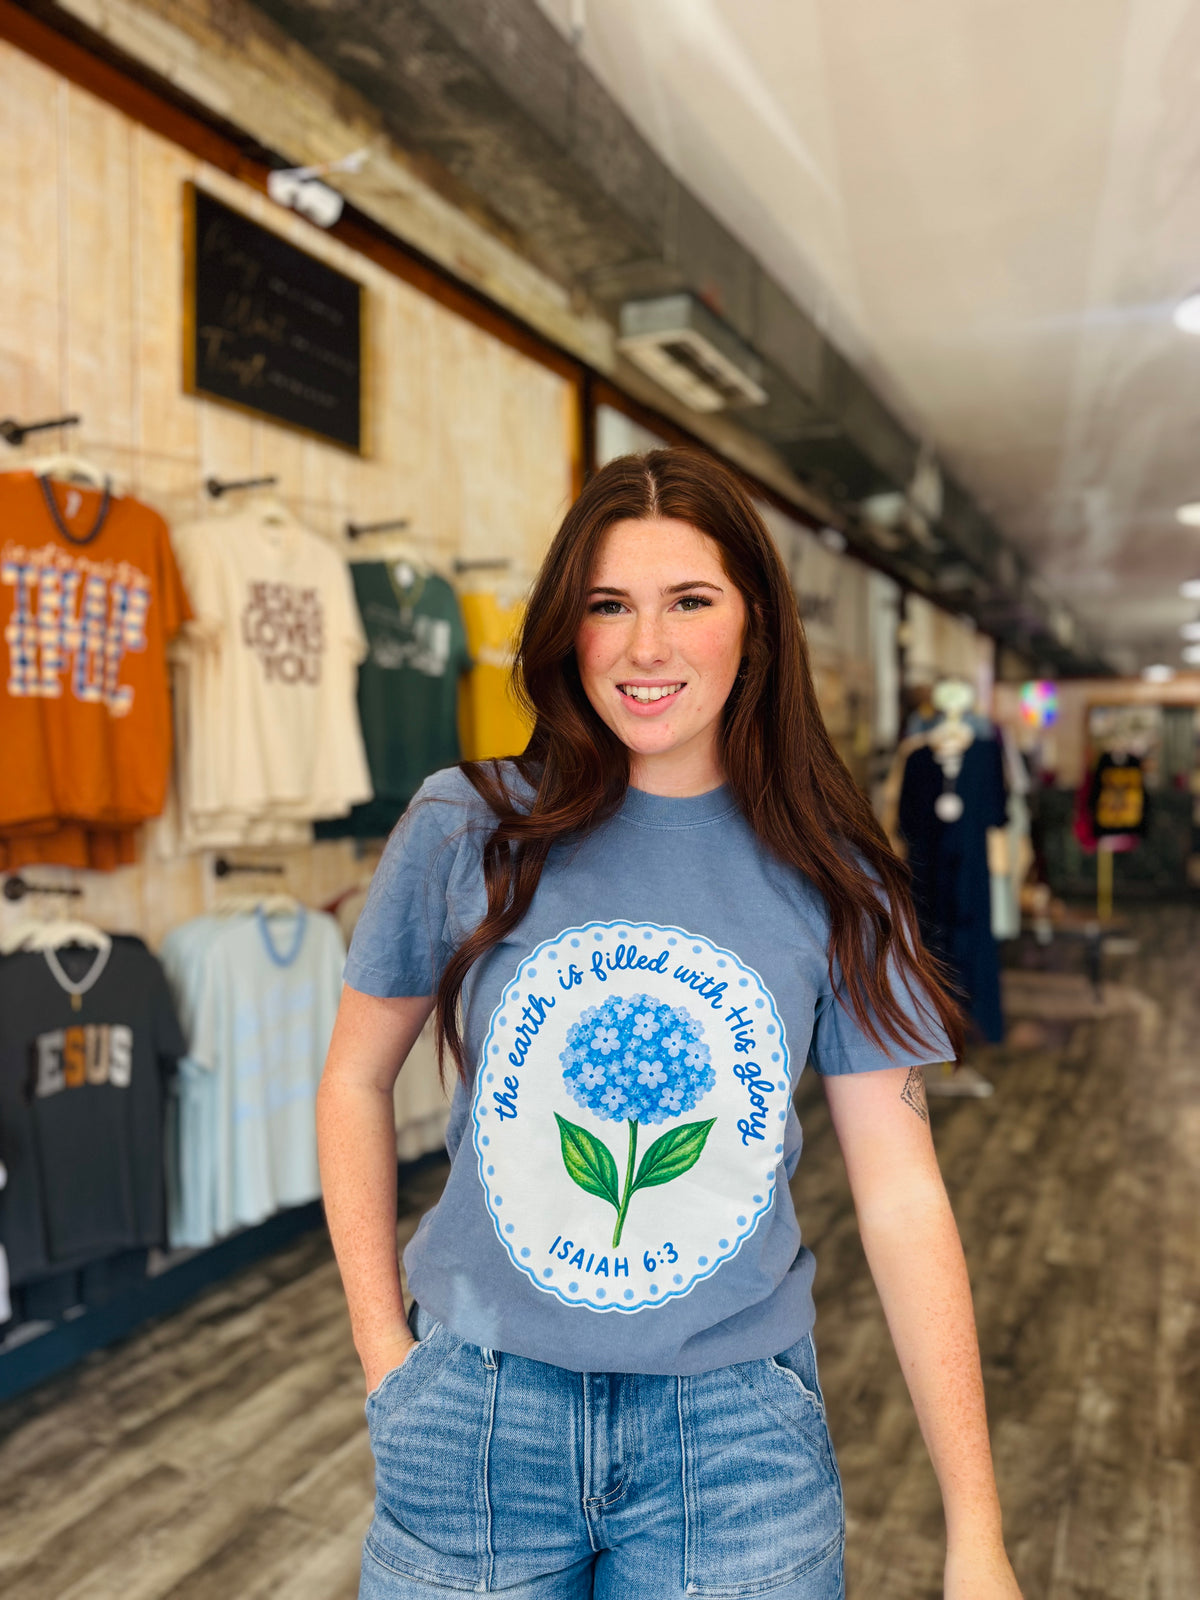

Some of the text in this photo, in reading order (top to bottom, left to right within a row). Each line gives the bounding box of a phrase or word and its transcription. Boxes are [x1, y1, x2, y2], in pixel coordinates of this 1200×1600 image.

[246, 579, 321, 612] JESUS
[240, 602, 325, 655] LOVES
[259, 652, 322, 686] YOU
[493, 944, 775, 1147] the earth is filled with His glory
[549, 1235, 679, 1278] ISAIAH 6:3
